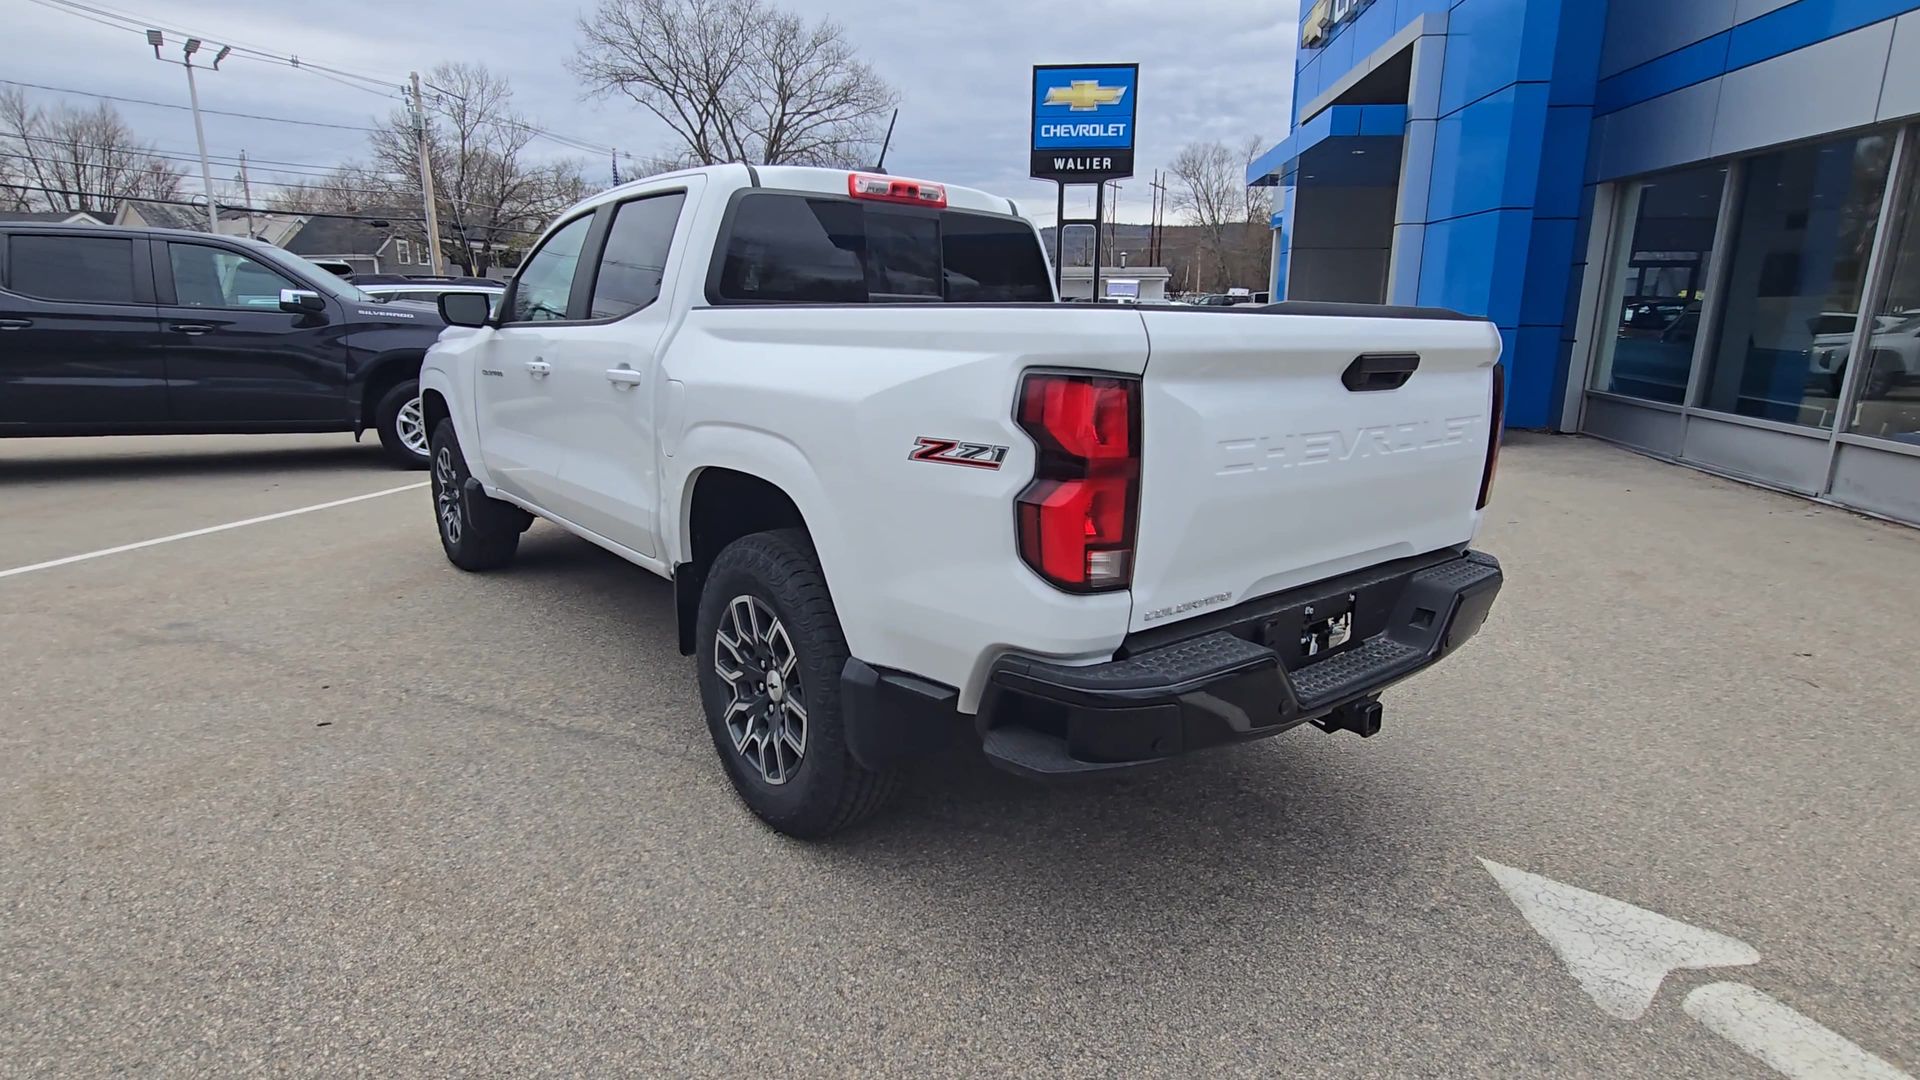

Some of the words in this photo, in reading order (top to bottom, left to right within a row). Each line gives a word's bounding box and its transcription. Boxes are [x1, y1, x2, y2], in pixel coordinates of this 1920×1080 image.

[1041, 123, 1126, 137] CHEVROLET
[1054, 157, 1112, 170] WALIER
[358, 310, 414, 318] SILVERADO
[1215, 415, 1481, 475] CHEVROLET
[908, 436, 1010, 471] Z71
